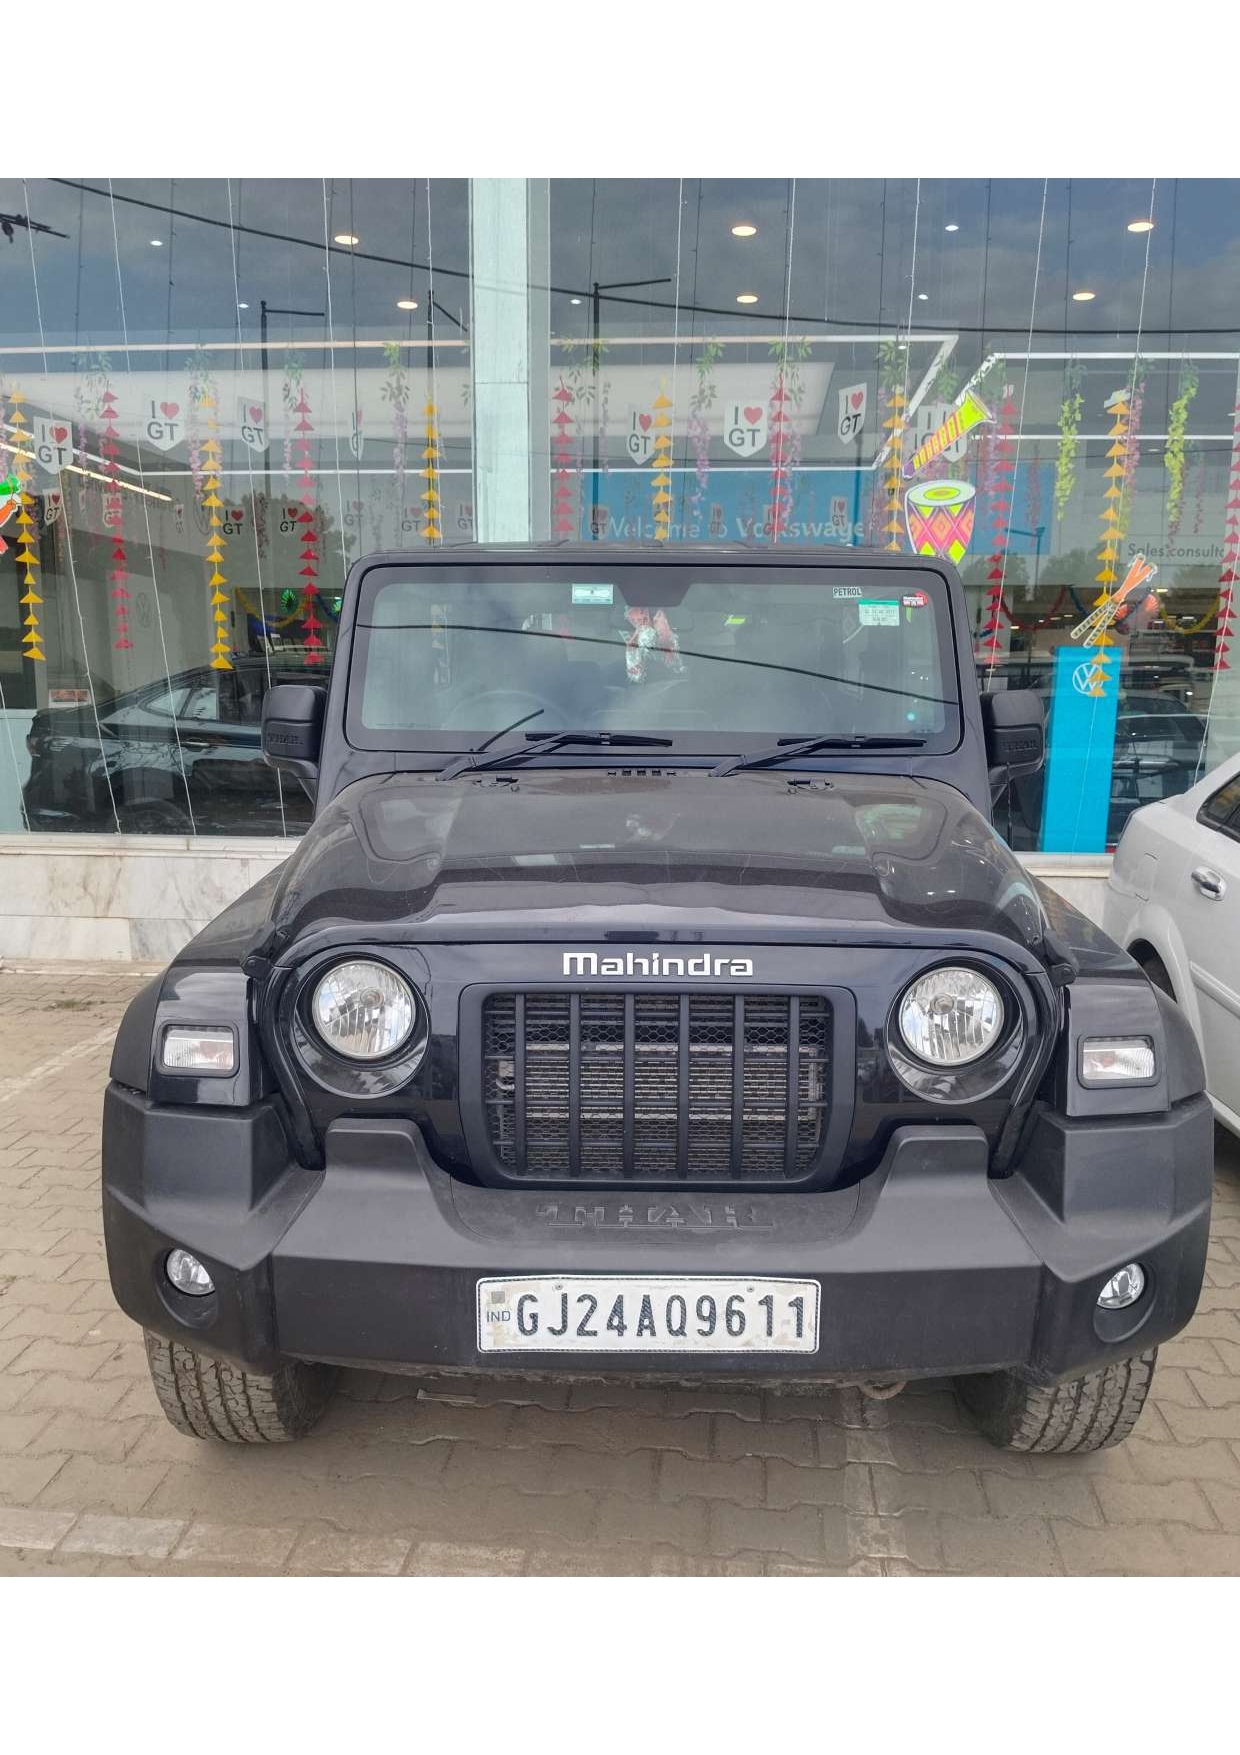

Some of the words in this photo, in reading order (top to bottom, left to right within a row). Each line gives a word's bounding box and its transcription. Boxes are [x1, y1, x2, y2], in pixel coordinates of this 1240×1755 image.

[147, 421, 179, 441] GT
[840, 413, 862, 436] GT
[241, 425, 264, 445] GT
[728, 428, 761, 447] GT
[628, 433, 651, 455] GT
[38, 444, 67, 466] GT
[46, 507, 60, 521] GT
[831, 514, 846, 527] GT
[222, 523, 244, 535] GT
[279, 521, 297, 532] GT
[401, 520, 421, 532] GT
[590, 521, 607, 535] GT
[602, 515, 700, 538] Welcme
[1127, 542, 1165, 557] Sales
[833, 586, 862, 597] PETROL
[562, 952, 754, 976] Mahindra
[486, 1310, 511, 1323] IND
[516, 1292, 805, 1338] GJ24AQ9611
